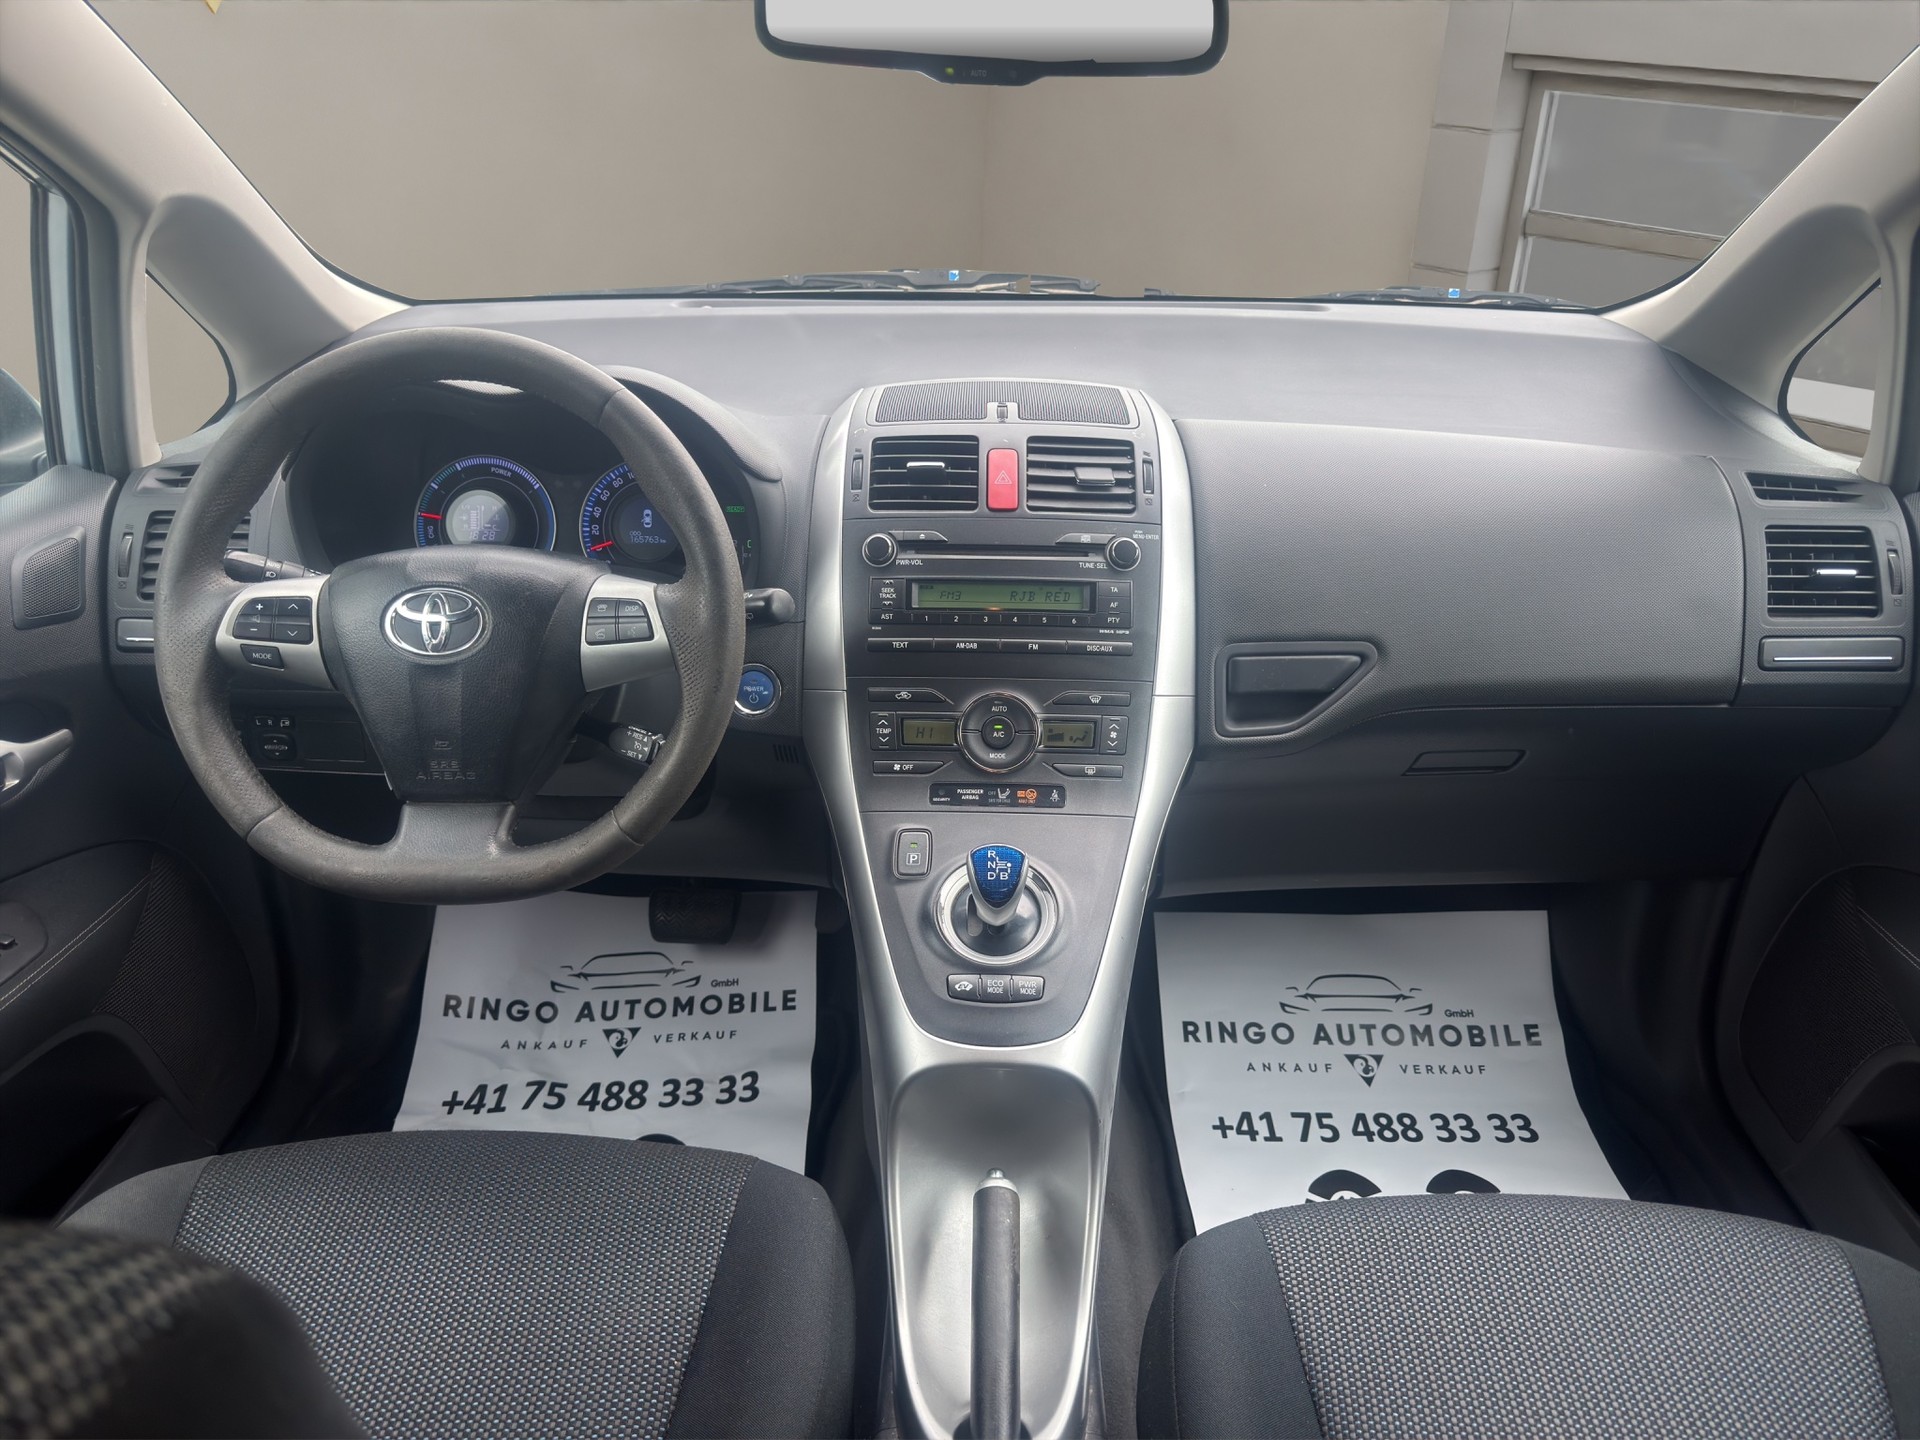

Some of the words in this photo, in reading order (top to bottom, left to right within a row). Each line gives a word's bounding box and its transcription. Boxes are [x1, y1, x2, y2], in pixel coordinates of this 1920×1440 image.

[970, 69, 987, 77] AUTO
[491, 466, 512, 477] POWER
[612, 477, 624, 488] 80
[600, 489, 611, 501] 60
[593, 506, 602, 518] 40
[427, 525, 435, 539] CHG
[591, 524, 599, 535] 20
[630, 536, 659, 544] 165763
[939, 590, 962, 600] FM3
[891, 641, 909, 649] TEXT
[1028, 643, 1039, 651] FM
[252, 652, 273, 661] MODE
[876, 727, 892, 735] TEMP
[989, 752, 1006, 760] MODE
[902, 763, 914, 771] OFF
[415, 772, 477, 780] AIRBAG
[909, 854, 918, 863] P
[987, 850, 996, 858] R
[987, 861, 996, 869] N
[987, 872, 996, 880] D
[1000, 872, 1009, 880] B
[711, 978, 739, 988] GmbH
[442, 994, 559, 1024] RINGO
[574, 989, 797, 1024] AUTOMOBILE
[1444, 1008, 1474, 1018] GmbH
[1182, 1021, 1295, 1045] RINGO
[1313, 1023, 1542, 1047] AUTOMOBILE
[501, 1038, 588, 1050] ANKAUF
[653, 1030, 738, 1044] VERKAUF
[1247, 1062, 1333, 1073] ANKAUF
[1400, 1064, 1487, 1075] VERKAUF
[441, 1083, 508, 1115] +41
[521, 1080, 568, 1110] 75
[577, 1080, 649, 1112] 488
[658, 1078, 704, 1107] 33
[715, 1070, 760, 1104] 33
[1212, 1111, 1283, 1142] +41
[1290, 1112, 1340, 1142] 75
[1351, 1112, 1424, 1143] 488
[1430, 1113, 1480, 1143] 33
[1486, 1113, 1539, 1143] 33
